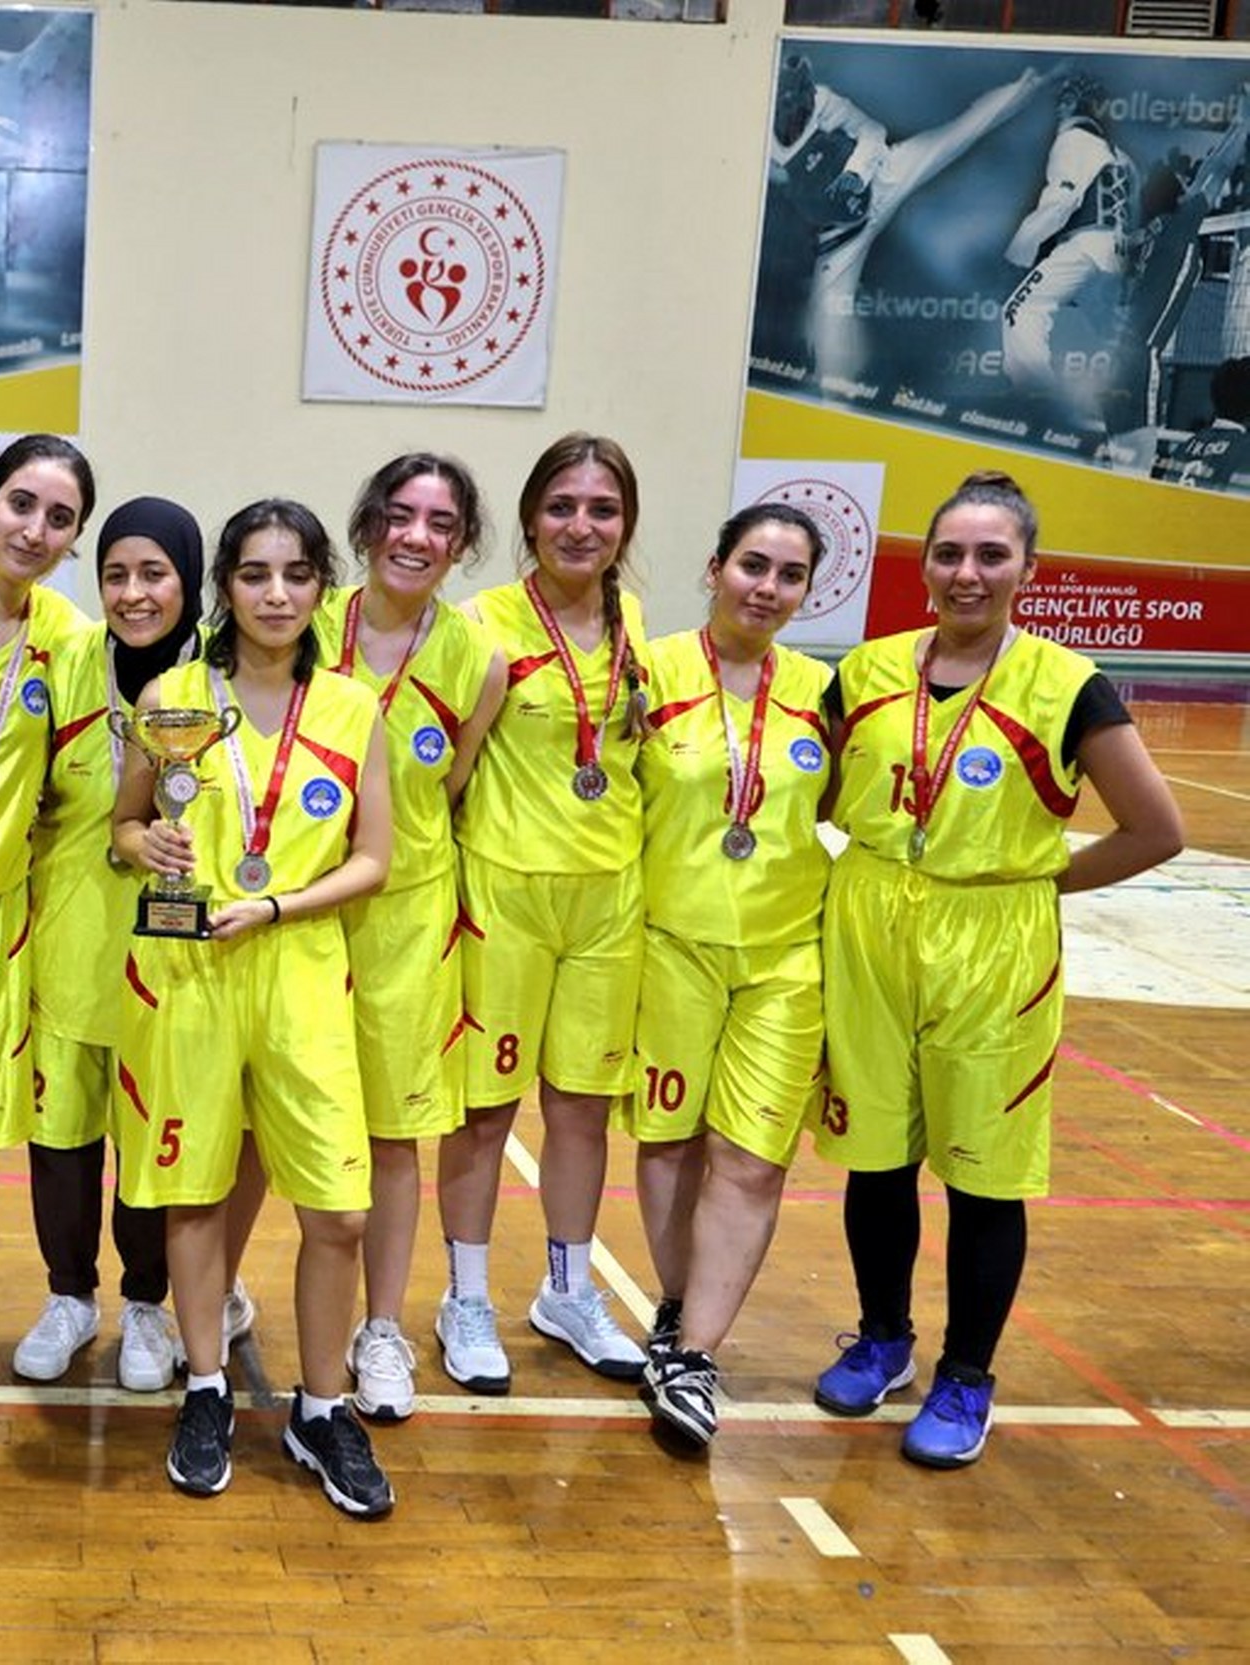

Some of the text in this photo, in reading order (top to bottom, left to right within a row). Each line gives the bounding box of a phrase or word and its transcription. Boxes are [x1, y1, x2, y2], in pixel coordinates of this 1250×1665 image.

[1093, 91, 1244, 129] volleyball
[416, 203, 477, 225] GENÇLİK
[1018, 595, 1204, 623] GENÇLİK VE SPOR
[1024, 621, 1143, 647] ÜDÜRLÜĞÜ
[494, 1032, 520, 1075] 8
[645, 1065, 687, 1112] 10
[821, 1085, 848, 1136] 13
[155, 1118, 184, 1168] 5
